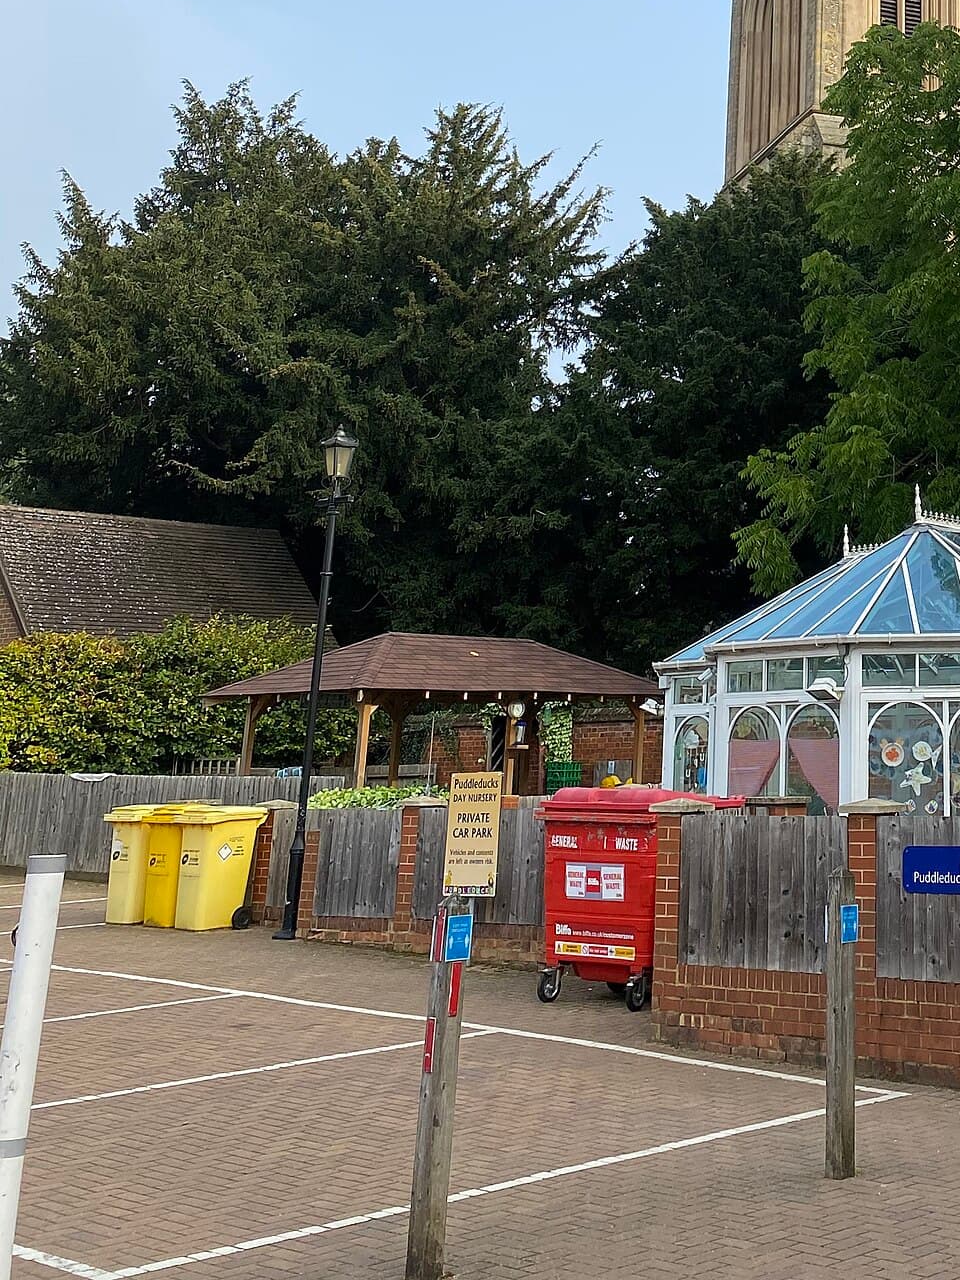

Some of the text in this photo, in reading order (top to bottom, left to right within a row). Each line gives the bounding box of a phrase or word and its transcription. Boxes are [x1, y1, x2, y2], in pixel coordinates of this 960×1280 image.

[454, 778, 498, 789] Puddleducks
[453, 793, 497, 802] DAY NURSERY
[458, 813, 490, 823] PRIVATE
[452, 828, 492, 838] CAR PARK
[552, 834, 578, 848] GENERAL
[615, 837, 638, 850] WASTE
[556, 923, 572, 935] Biffa
